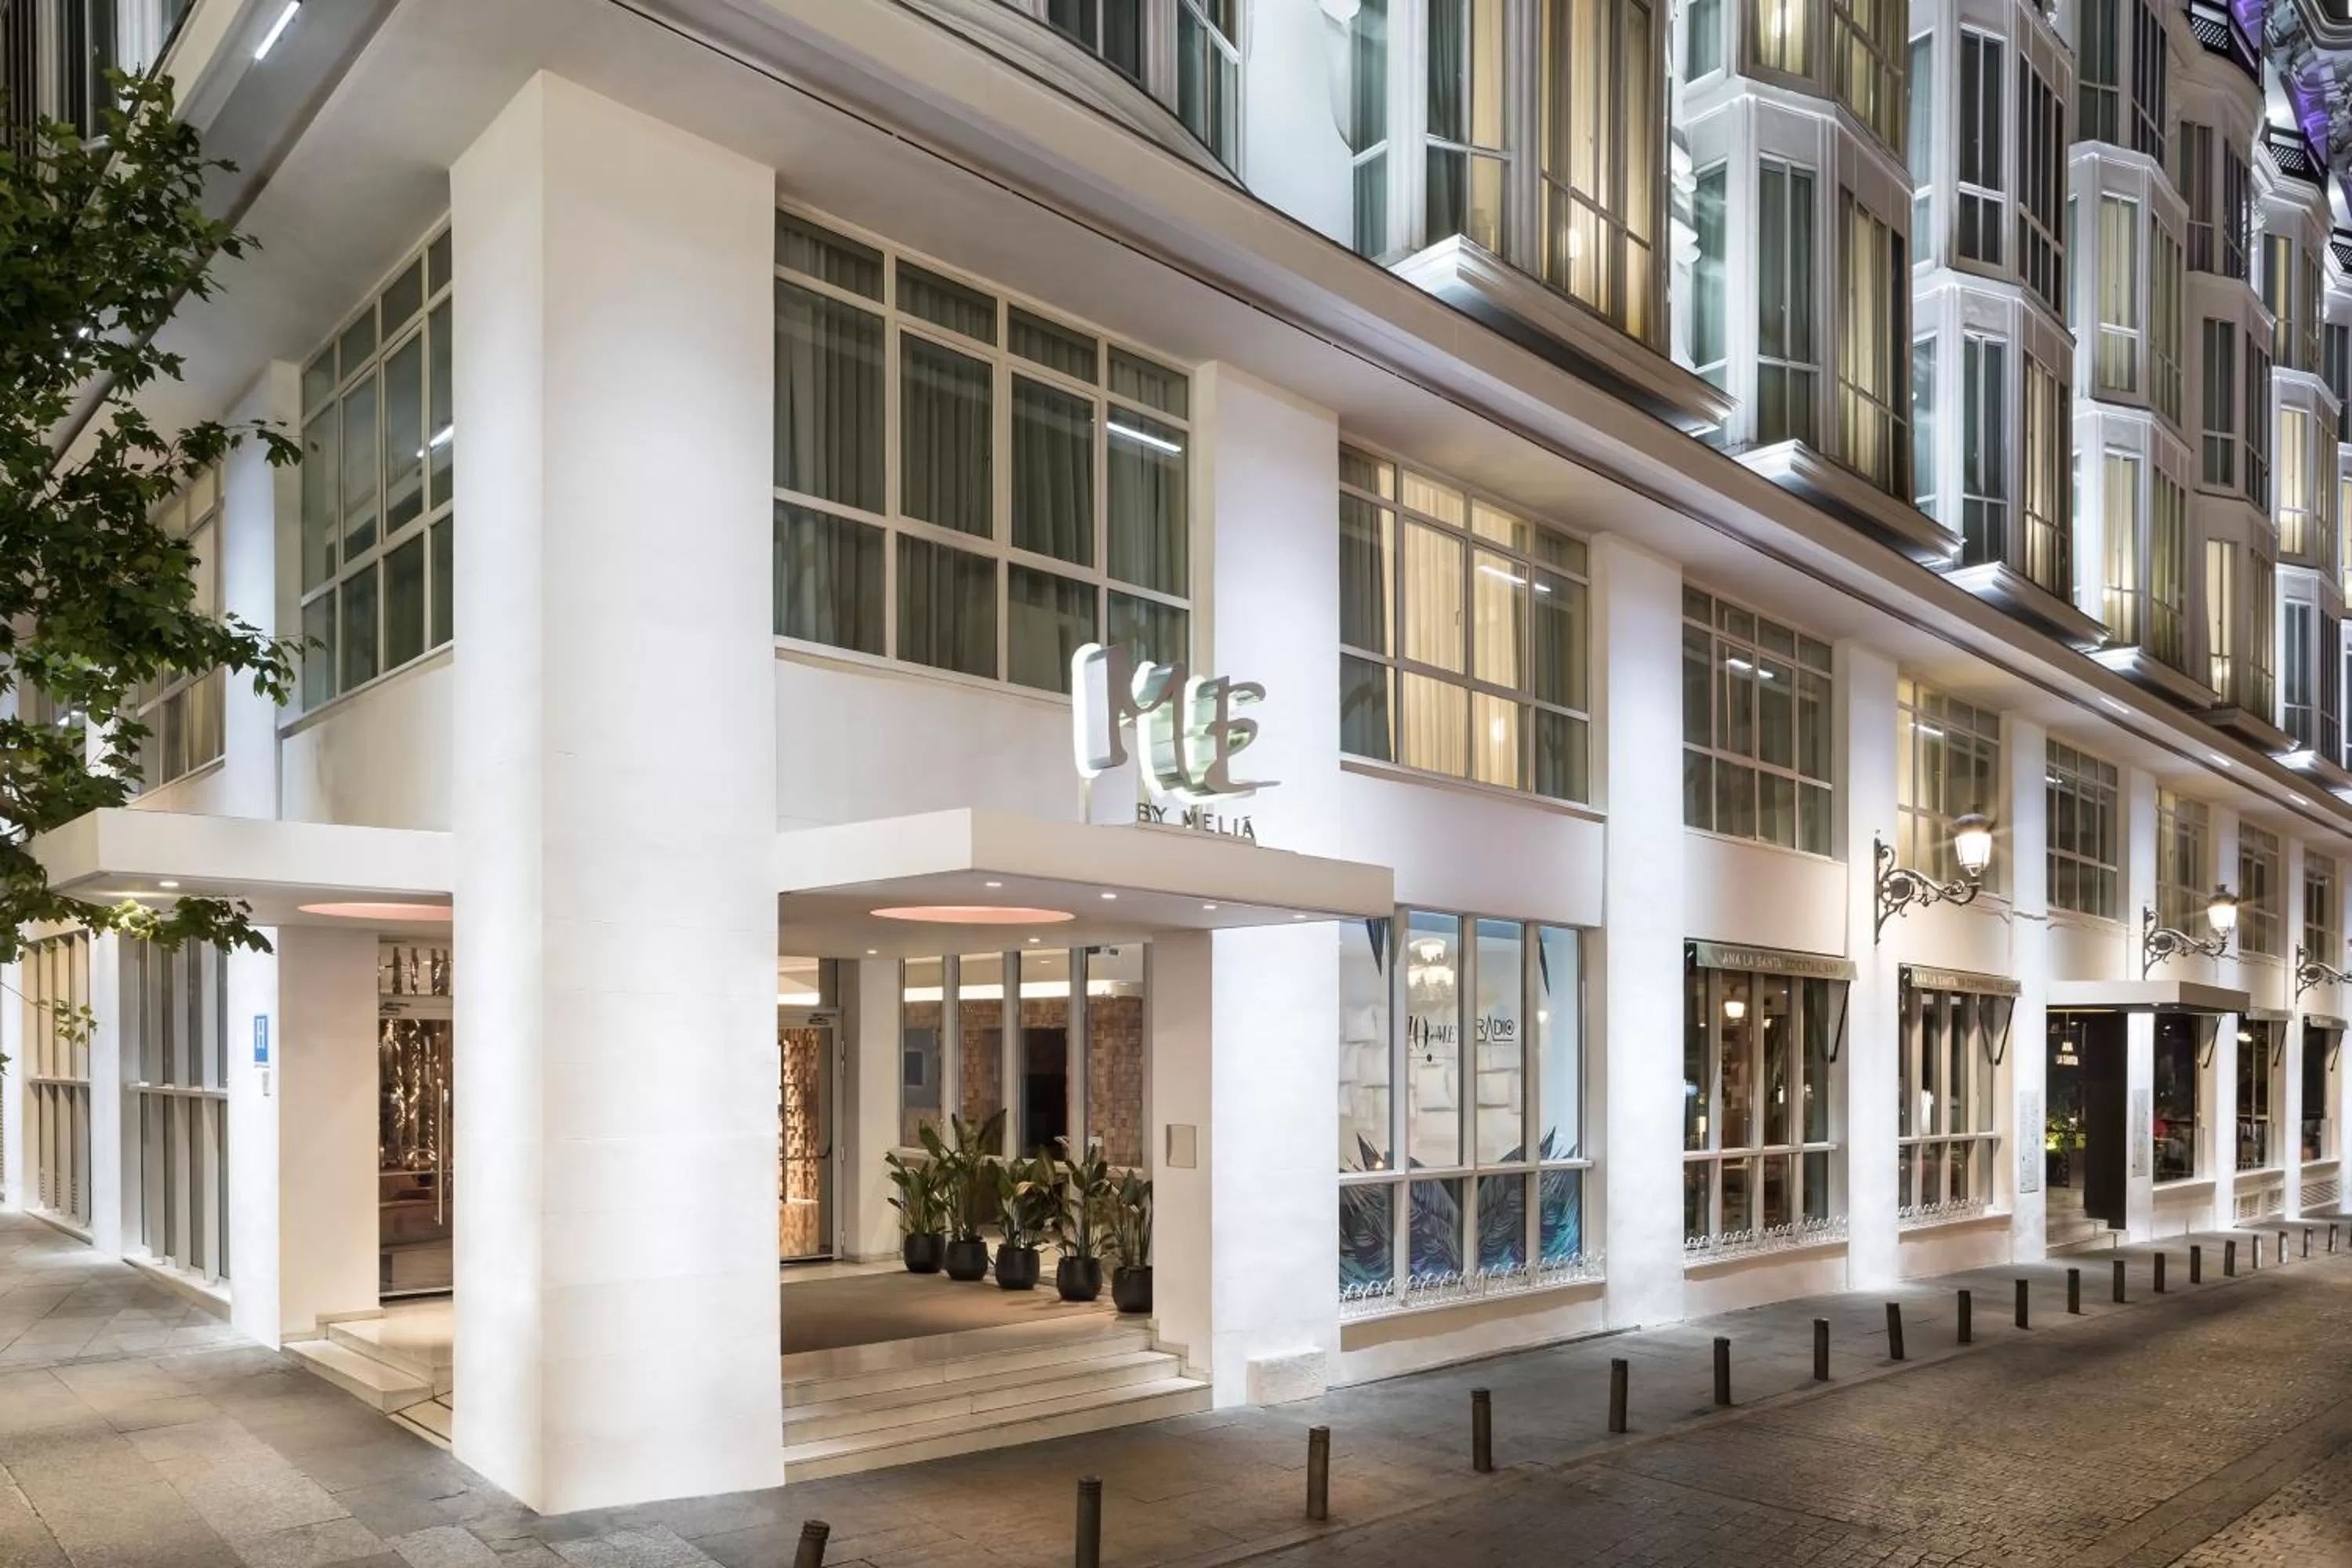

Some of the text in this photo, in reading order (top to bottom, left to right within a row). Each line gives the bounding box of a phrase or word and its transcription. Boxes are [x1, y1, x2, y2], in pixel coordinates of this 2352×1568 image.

[1137, 802, 1167, 823] BY
[1722, 953, 1740, 965] ANA
[1743, 954, 1755, 967] LA
